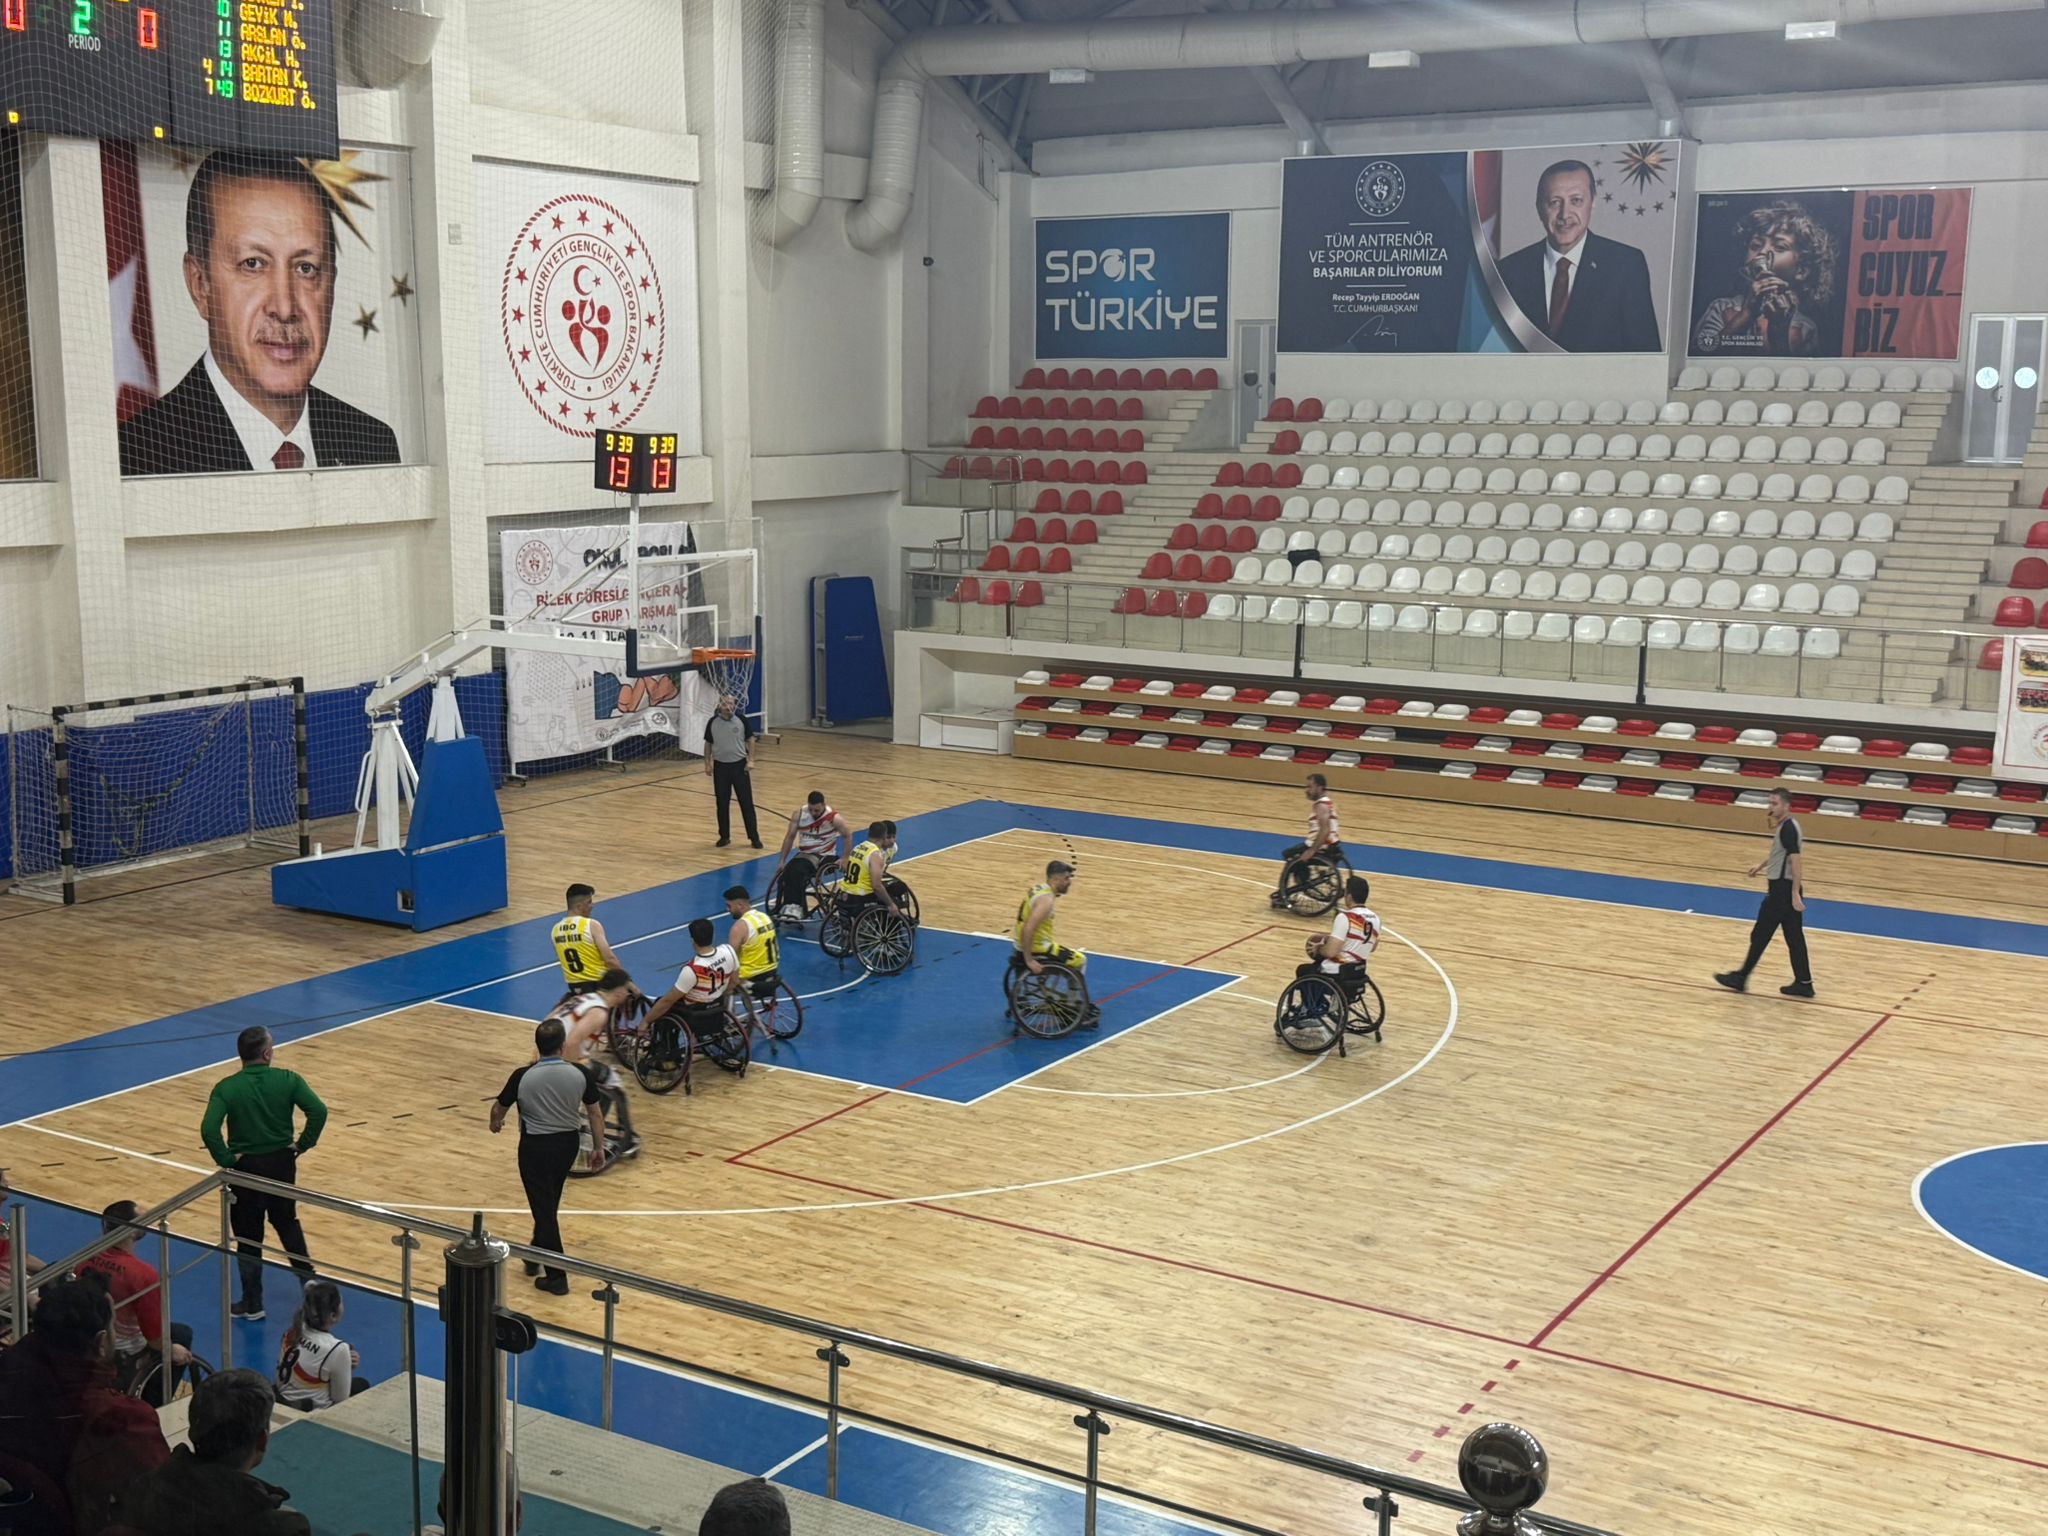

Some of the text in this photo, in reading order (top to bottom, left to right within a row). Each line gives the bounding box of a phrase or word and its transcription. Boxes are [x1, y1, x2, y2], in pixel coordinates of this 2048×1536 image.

[73, 0, 91, 34] 2
[138, 8, 158, 48] 0
[68, 33, 101, 51] PERIOD
[219, 20, 231, 36] 11
[241, 23, 287, 46] ARSLAN
[203, 58, 212, 75] 4
[242, 63, 288, 86] BARTAN
[217, 80, 233, 98] 49
[243, 83, 297, 106] BOZKURT
[1863, 194, 1935, 241] SPOR
[1325, 231, 1433, 247] TÜM ANTRENÖR
[1045, 247, 1156, 283] SPOR
[1309, 248, 1448, 262] VE SPORCULARIMIZA
[1313, 264, 1442, 280] BAŞARILAR DİLİYORUM
[1045, 289, 1218, 331] TÜRKİYE
[1333, 292, 1420, 302] Recep Tayyip ERDOĞAN
[1348, 304, 1418, 314] CUMHURBAŞKANI
[534, 239, 638, 392] TÜRKİYE CUMHURİYETİ GENÇLİK VE SPOR BAKANLIĞI
[1855, 303, 1900, 353] BİZ
[609, 456, 631, 488] 13
[652, 458, 671, 489] 13
[592, 609, 623, 624] GRUP
[1362, 921, 1374, 944] 9
[564, 948, 585, 973] 9
